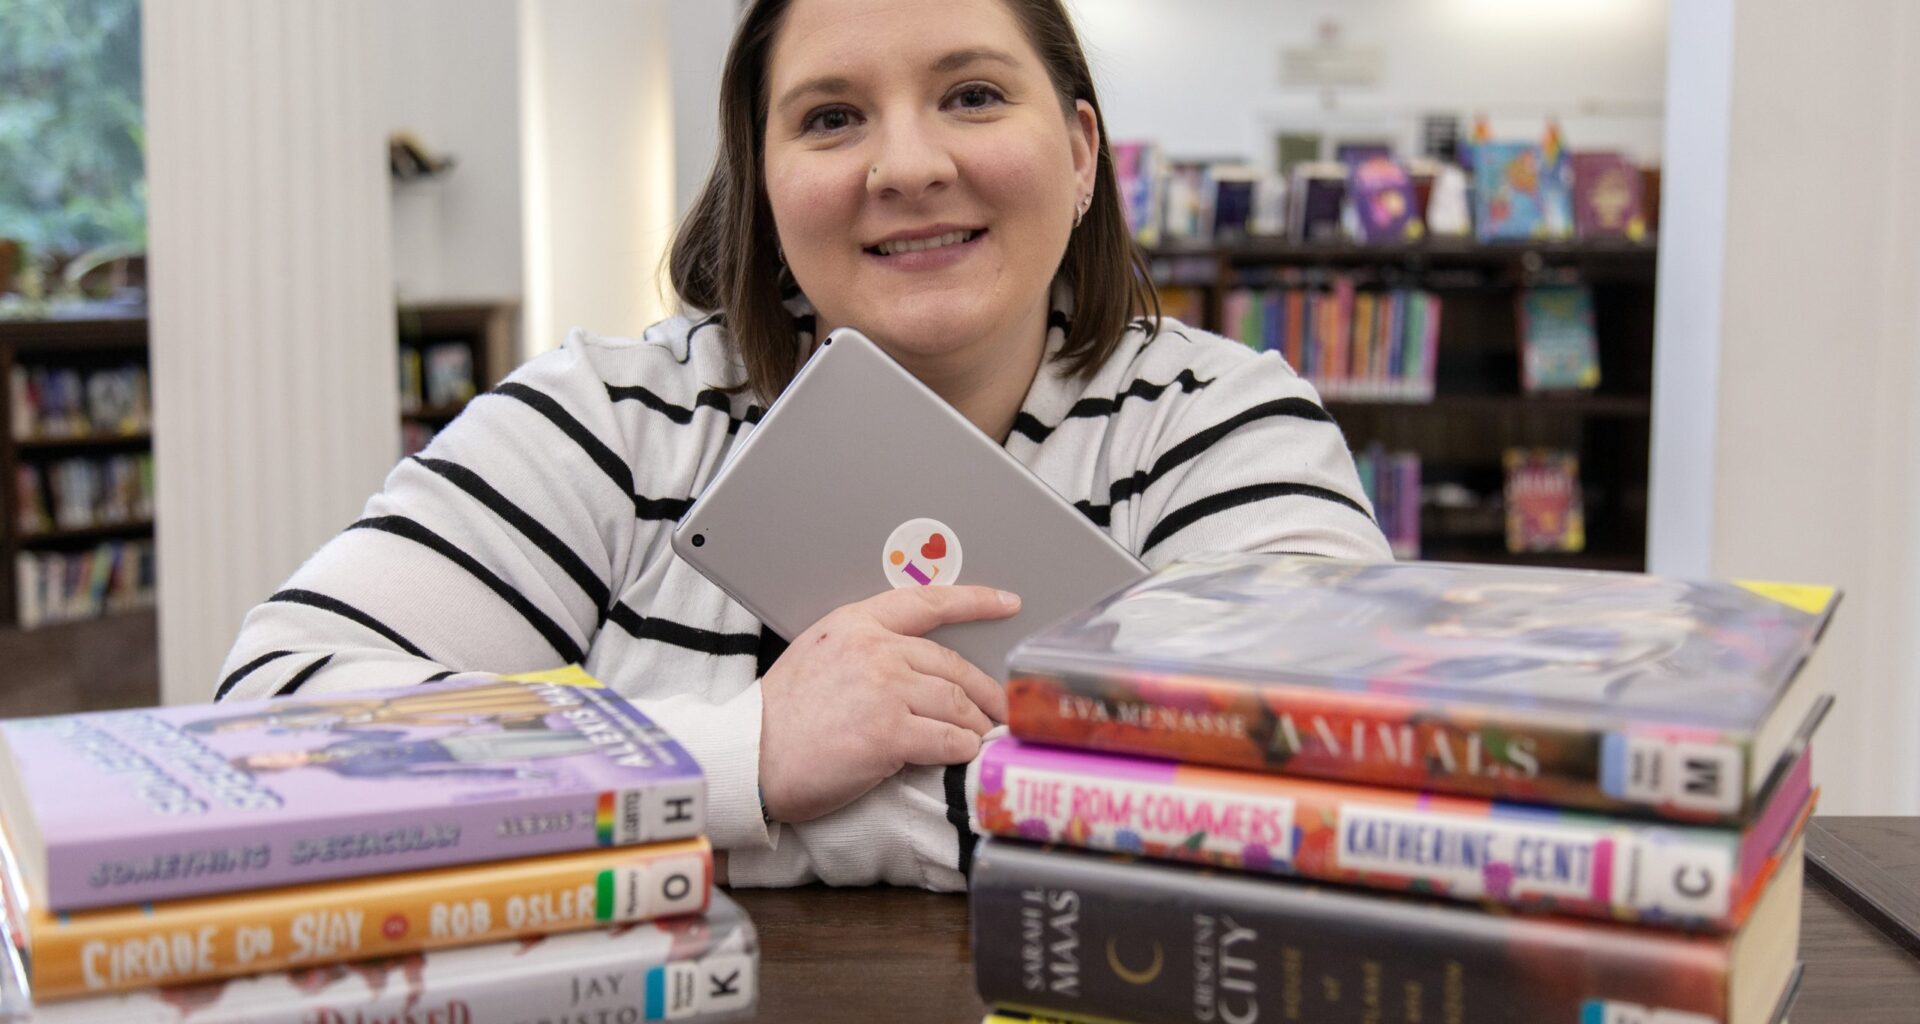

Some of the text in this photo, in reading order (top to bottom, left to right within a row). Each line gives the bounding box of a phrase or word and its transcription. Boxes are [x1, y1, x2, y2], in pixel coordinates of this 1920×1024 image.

[1058, 695, 1110, 722] EVA
[1270, 712, 1540, 779] ANIMALS
[1685, 757, 1721, 797] M
[665, 798, 693, 824] H
[1016, 778, 1283, 848] THE ROM-COMMERS
[1347, 818, 1493, 870] KATHERINE
[1516, 836, 1591, 888] CENT
[662, 873, 690, 900] O
[1673, 863, 1713, 899] C
[429, 883, 595, 937] ROB OSLER
[81, 925, 219, 989] CIRQUE
[289, 910, 363, 963] SLAY
[1022, 906, 1045, 991] SARAH
[1050, 889, 1080, 997] MAAS
[1218, 914, 1259, 1024] CITY
[571, 973, 624, 1006] JAY
[709, 969, 740, 998] K
